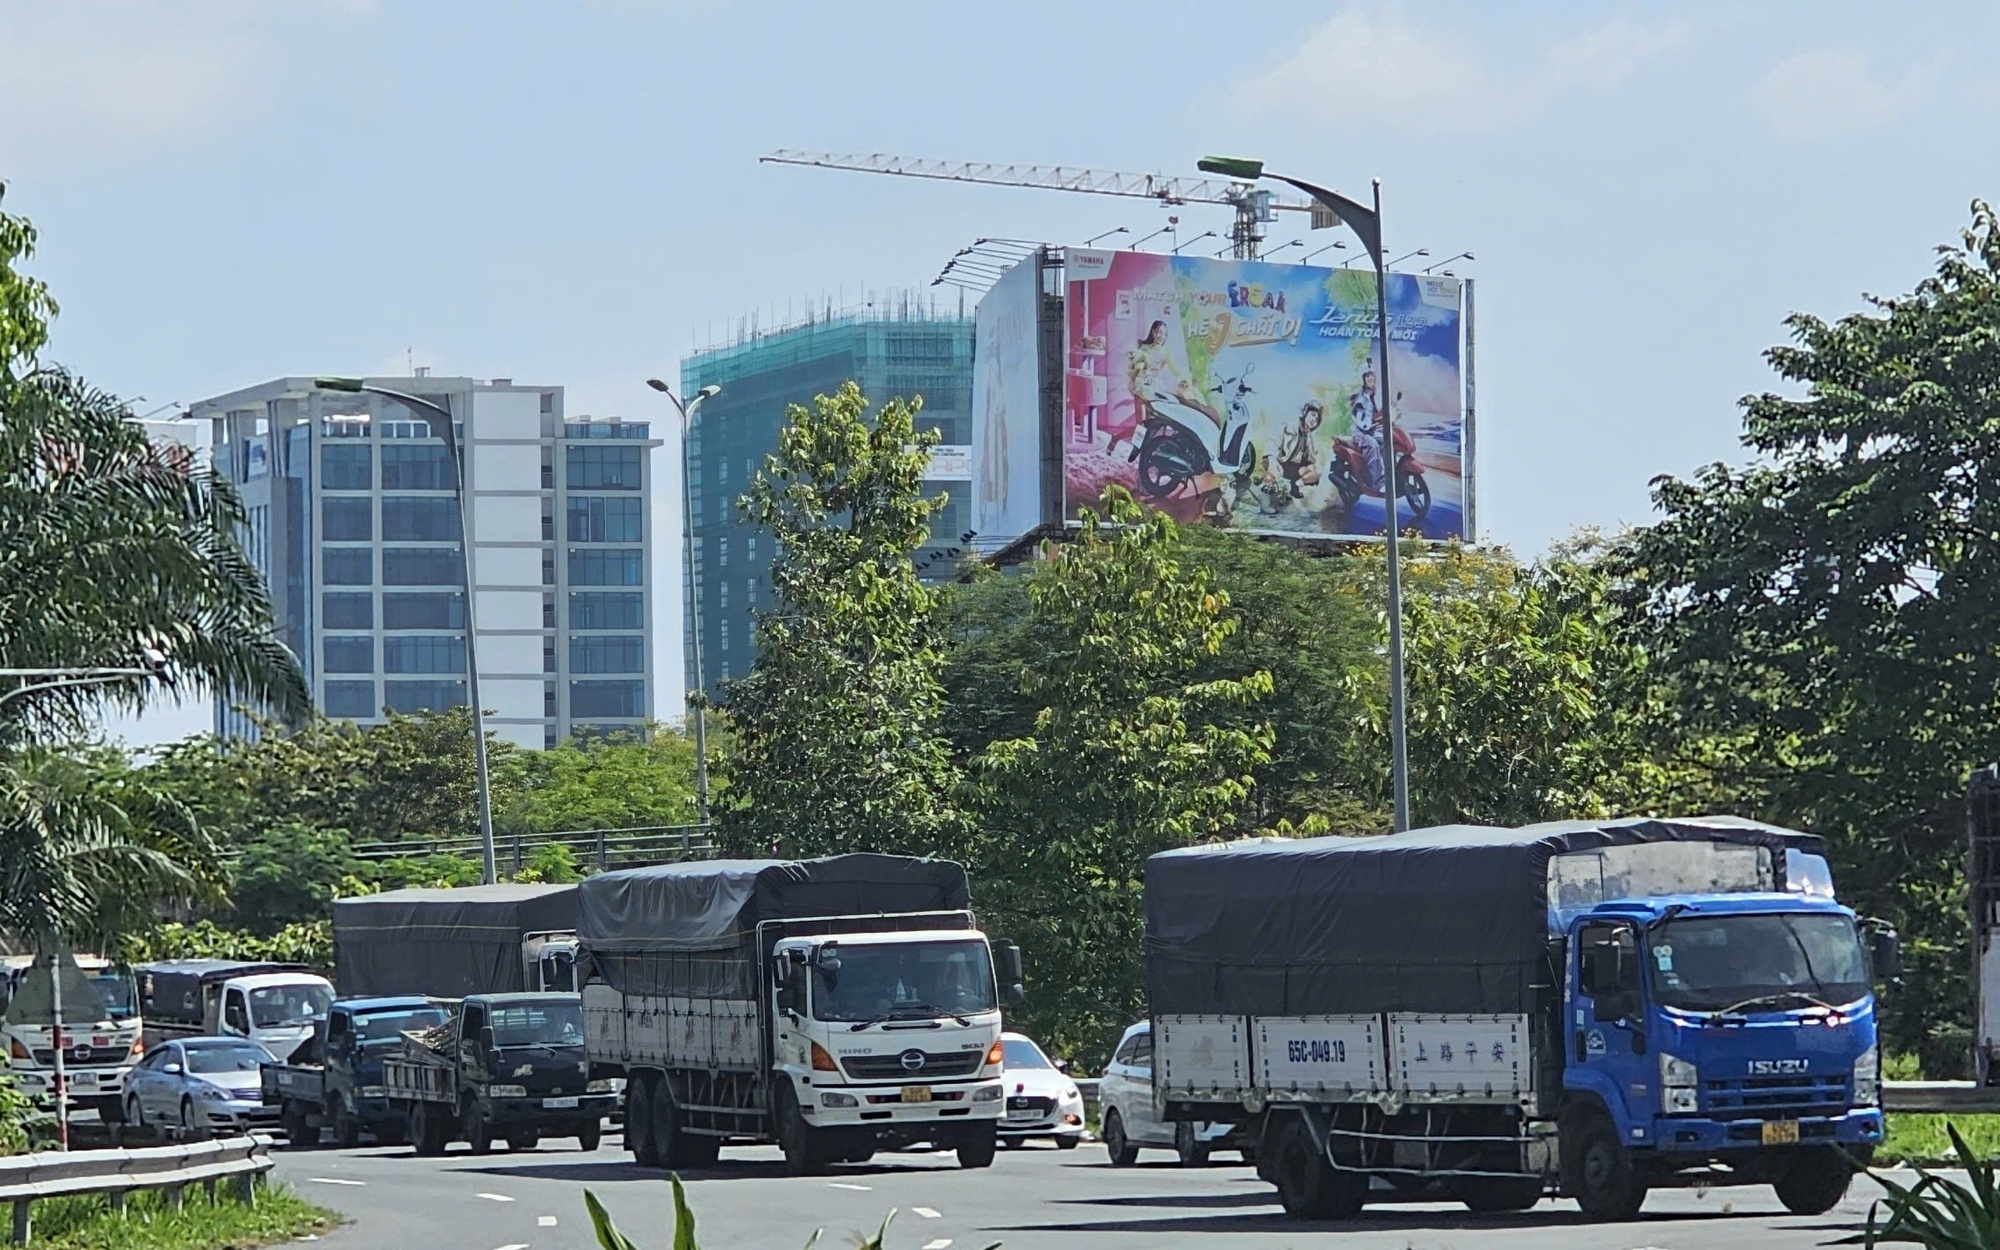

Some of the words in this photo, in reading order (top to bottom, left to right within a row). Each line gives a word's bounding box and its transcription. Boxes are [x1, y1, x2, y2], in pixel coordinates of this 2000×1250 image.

[1080, 256, 1104, 265] YAMAHA
[1396, 314, 1427, 328] 125
[1288, 1039, 1346, 1063] 65C-049.19
[1748, 1059, 1809, 1074] ISUZU
